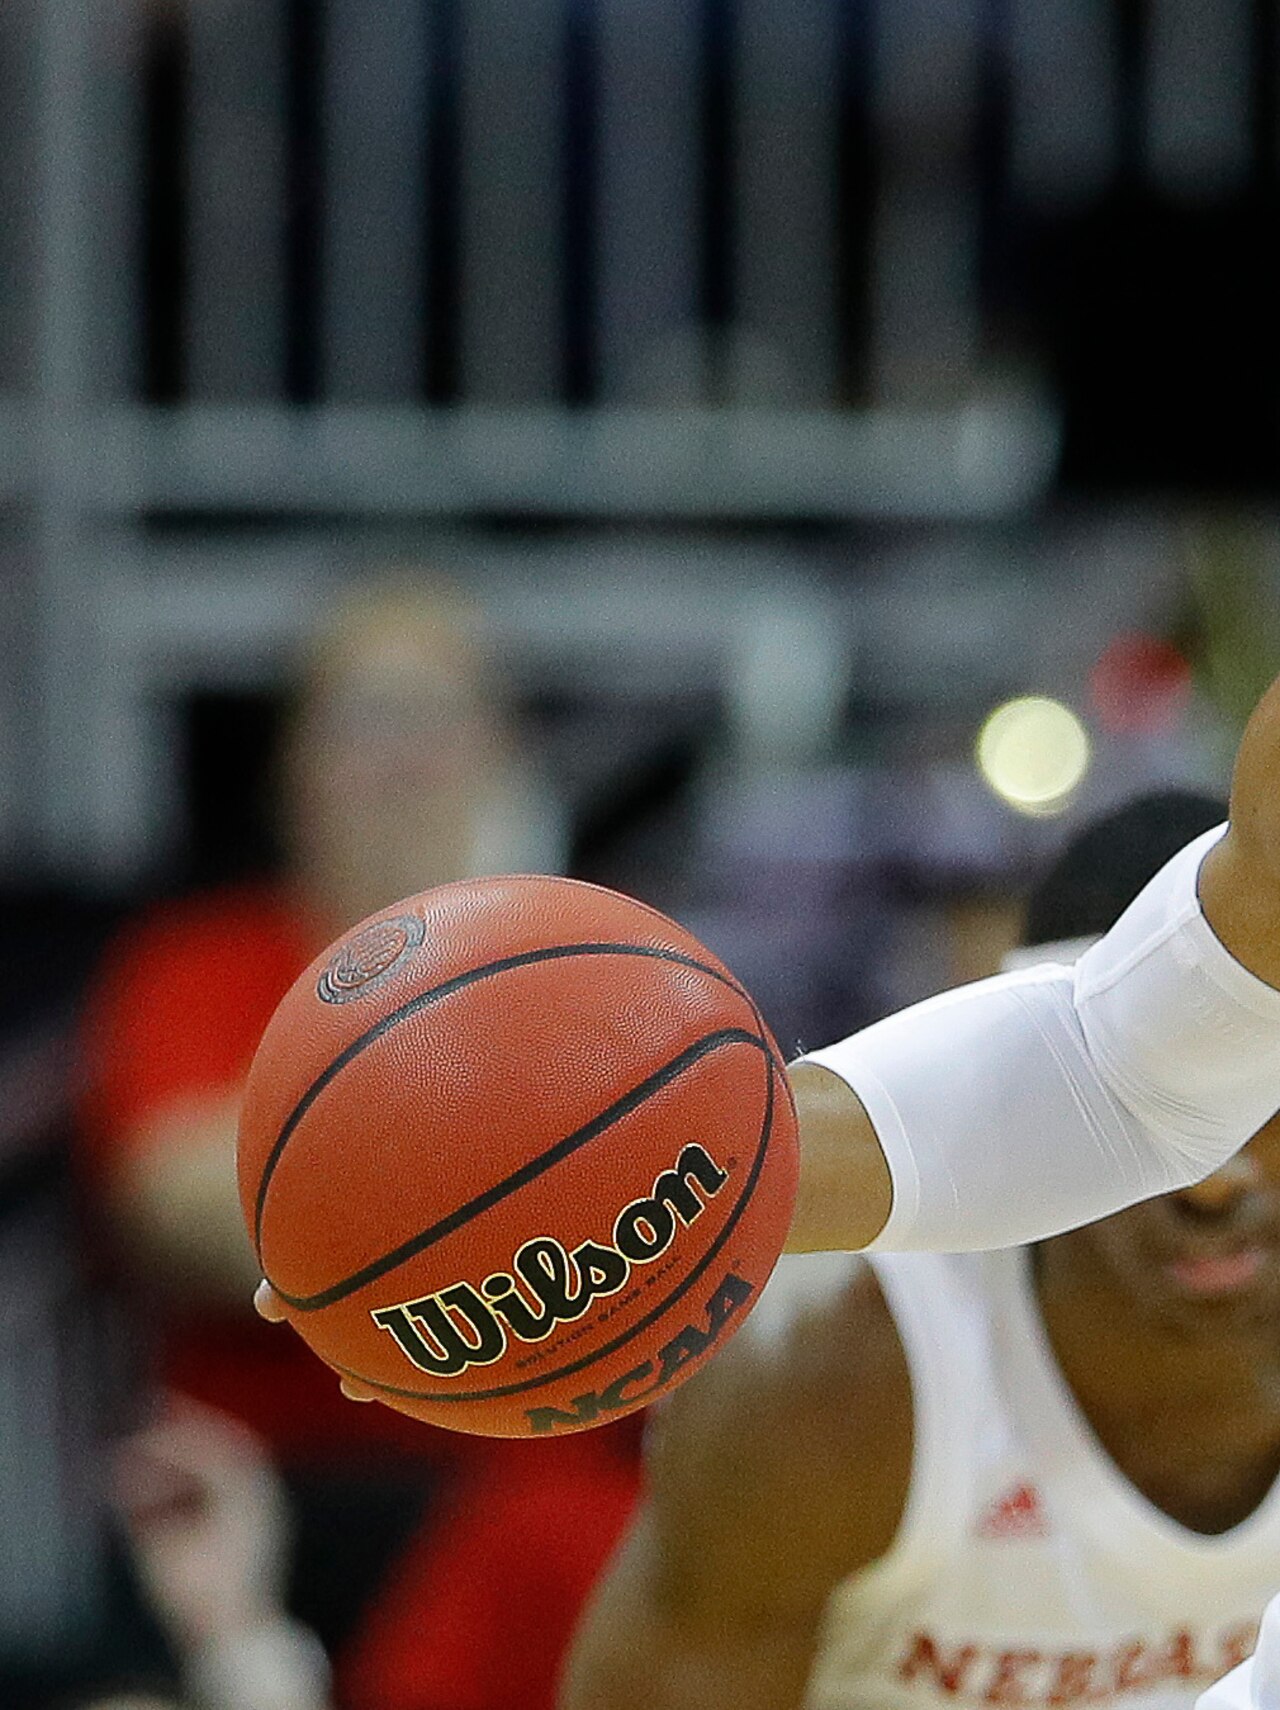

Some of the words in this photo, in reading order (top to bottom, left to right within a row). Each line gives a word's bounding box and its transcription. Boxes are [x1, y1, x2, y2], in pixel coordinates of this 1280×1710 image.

[370, 1142, 729, 1377] Wilson
[515, 1323, 594, 1369] SOLUTION
[598, 1288, 642, 1322] GAME
[524, 1272, 755, 1431] NCAA
